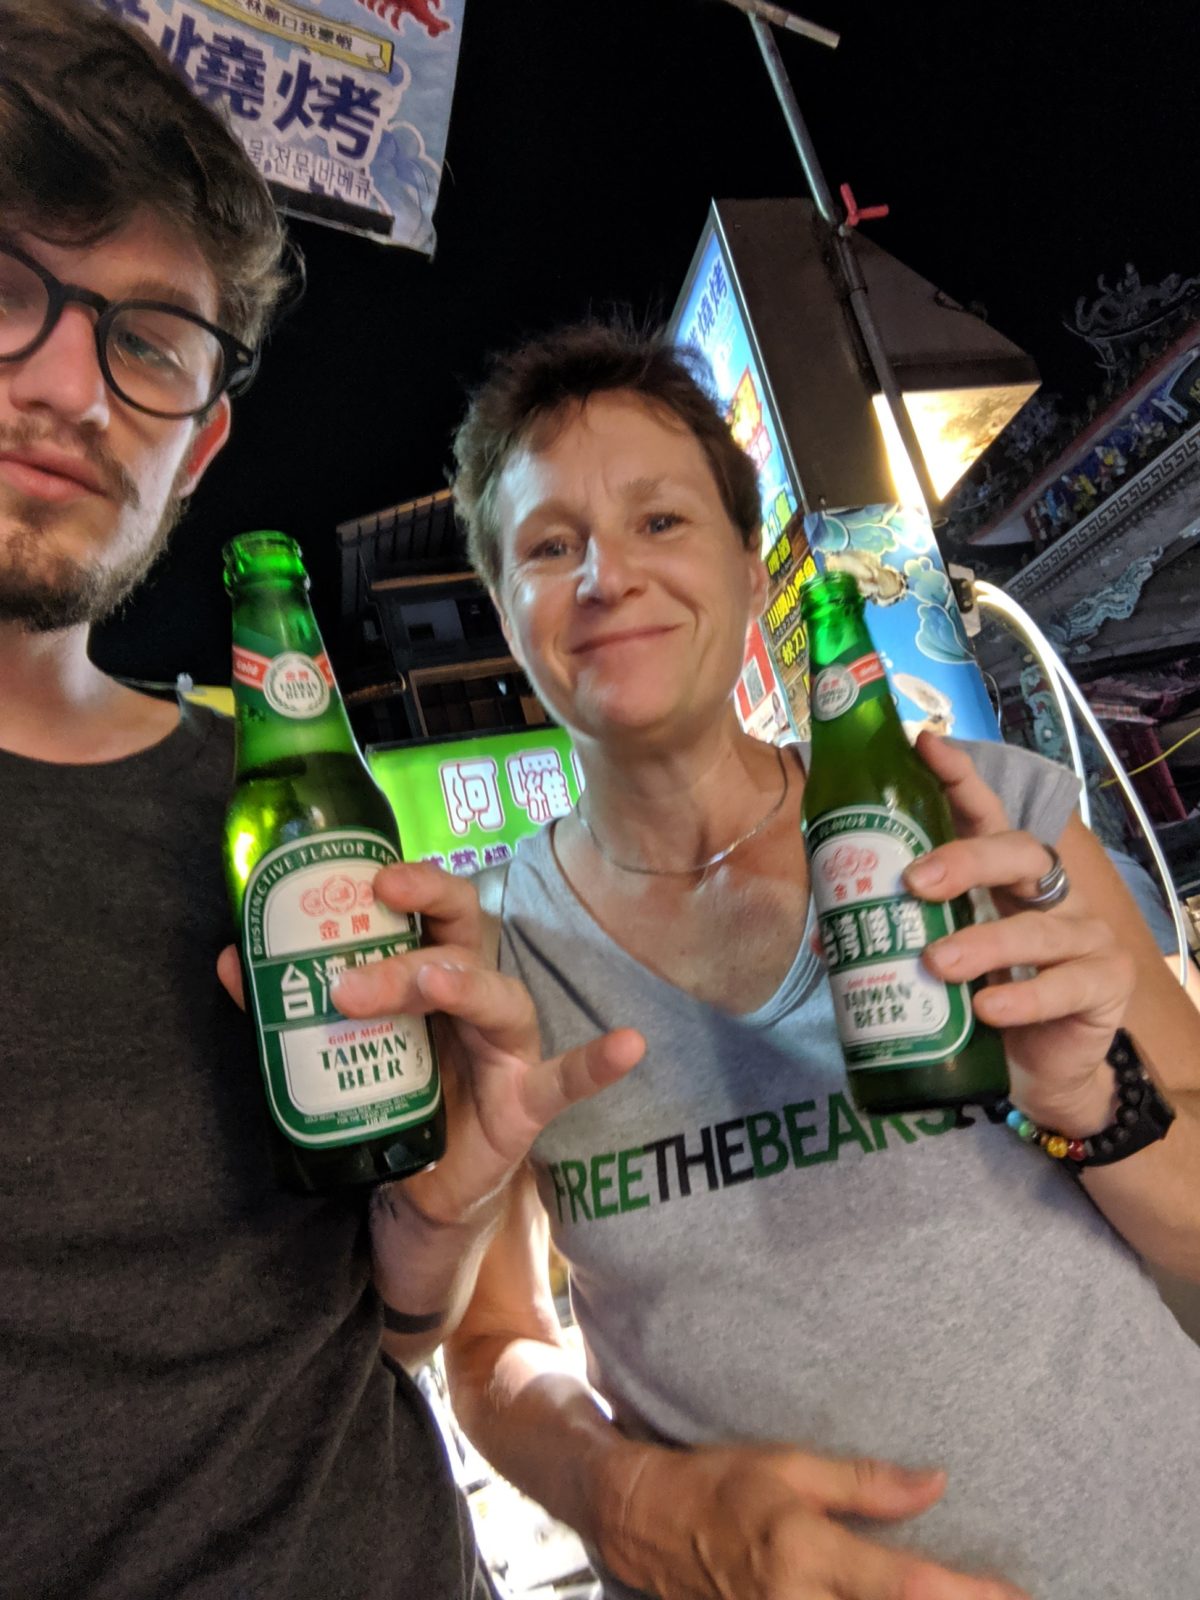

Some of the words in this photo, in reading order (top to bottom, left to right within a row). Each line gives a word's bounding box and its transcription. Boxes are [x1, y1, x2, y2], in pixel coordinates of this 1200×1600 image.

[108, 0, 382, 160] 燒烤
[300, 842, 366, 865] FLAVOR
[371, 845, 396, 865] LAG
[328, 1031, 356, 1046] Gold
[360, 1022, 394, 1040] Medal
[317, 1032, 408, 1071] TAIWAN
[337, 1058, 404, 1092] BEER
